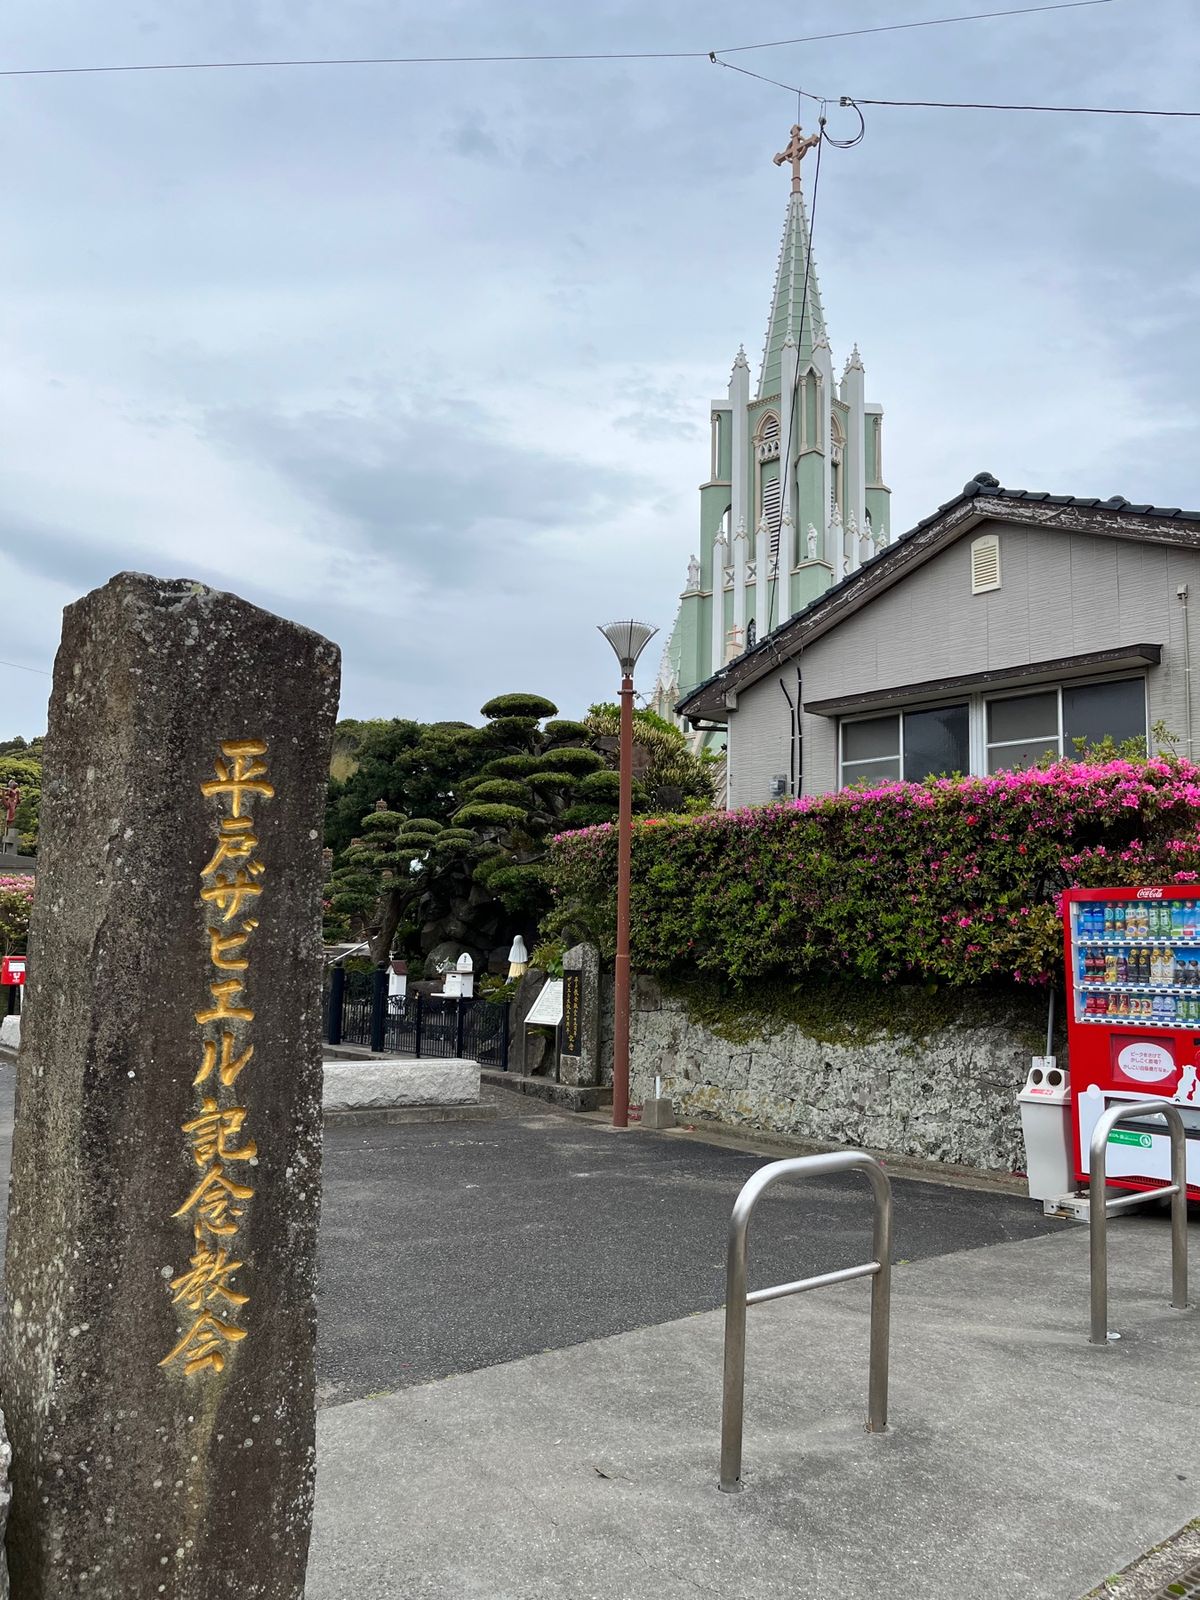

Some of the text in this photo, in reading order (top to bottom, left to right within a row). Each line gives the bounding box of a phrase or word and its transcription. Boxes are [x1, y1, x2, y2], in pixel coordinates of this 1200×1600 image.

[157, 738, 275, 1377] 平戸ザビエル記念教会
